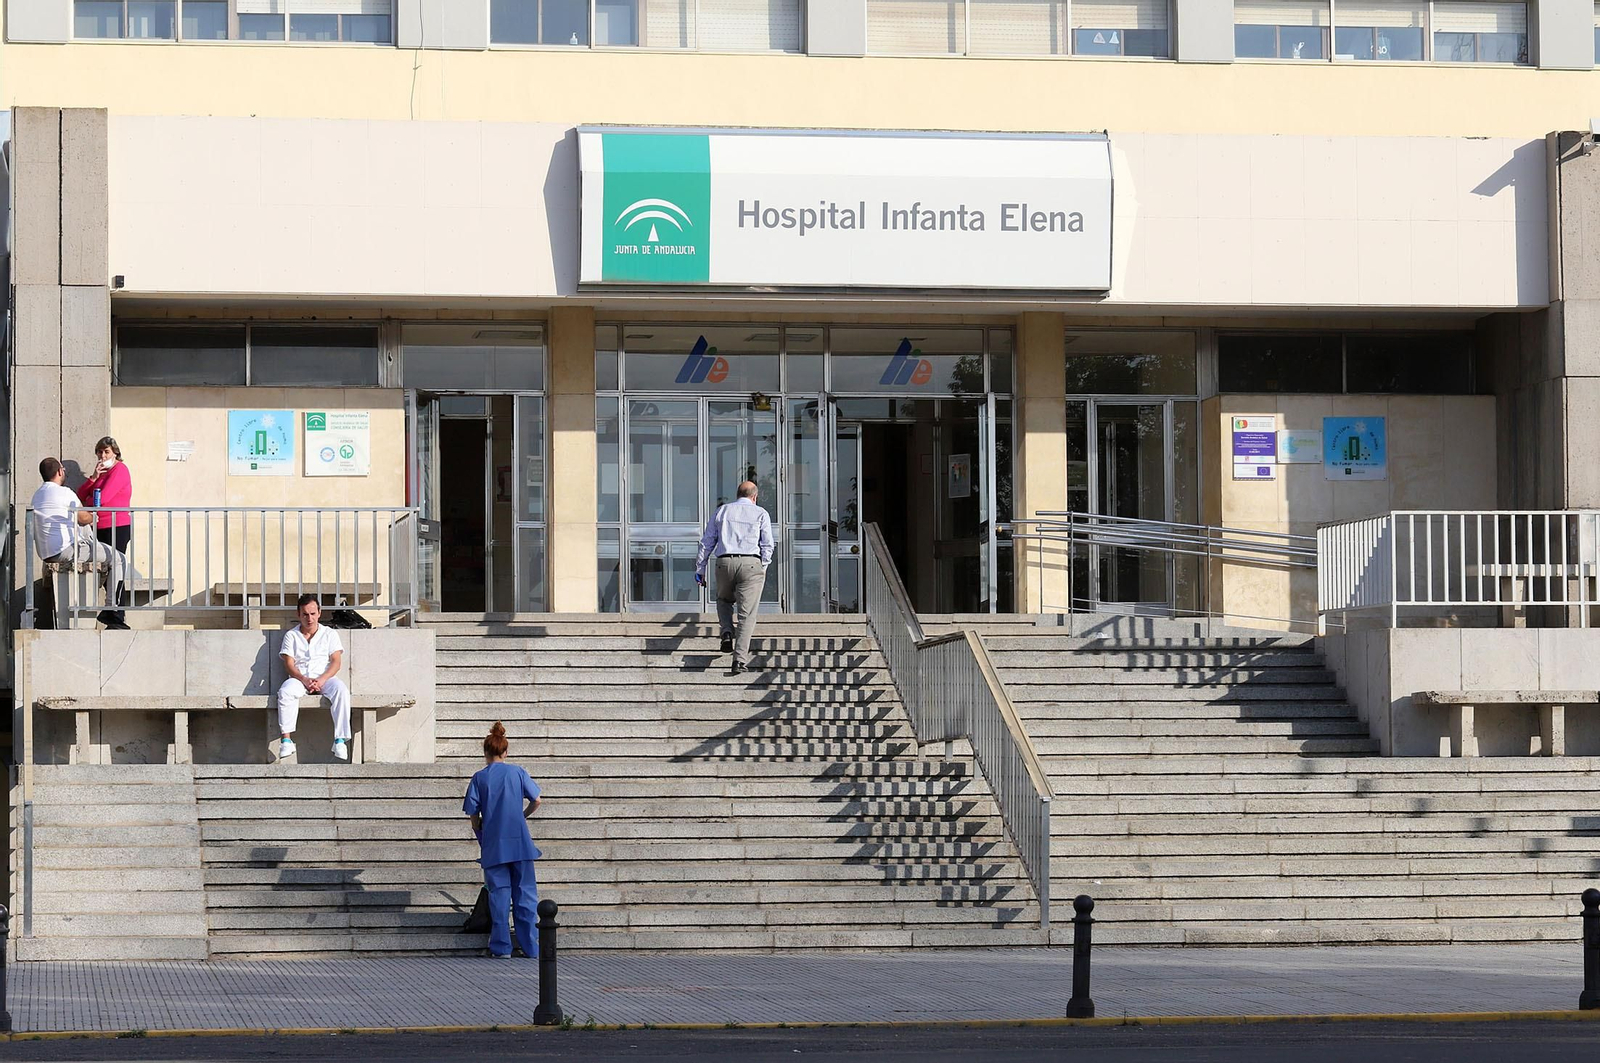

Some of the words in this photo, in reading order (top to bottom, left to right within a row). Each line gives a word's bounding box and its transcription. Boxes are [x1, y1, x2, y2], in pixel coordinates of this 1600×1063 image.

[738, 199, 866, 236] Hospital
[881, 201, 986, 232] Infanta
[1000, 203, 1084, 233] Elena
[614, 245, 638, 254] JUNTA
[642, 245, 651, 255] DE
[654, 245, 696, 255] ANDALUCIA
